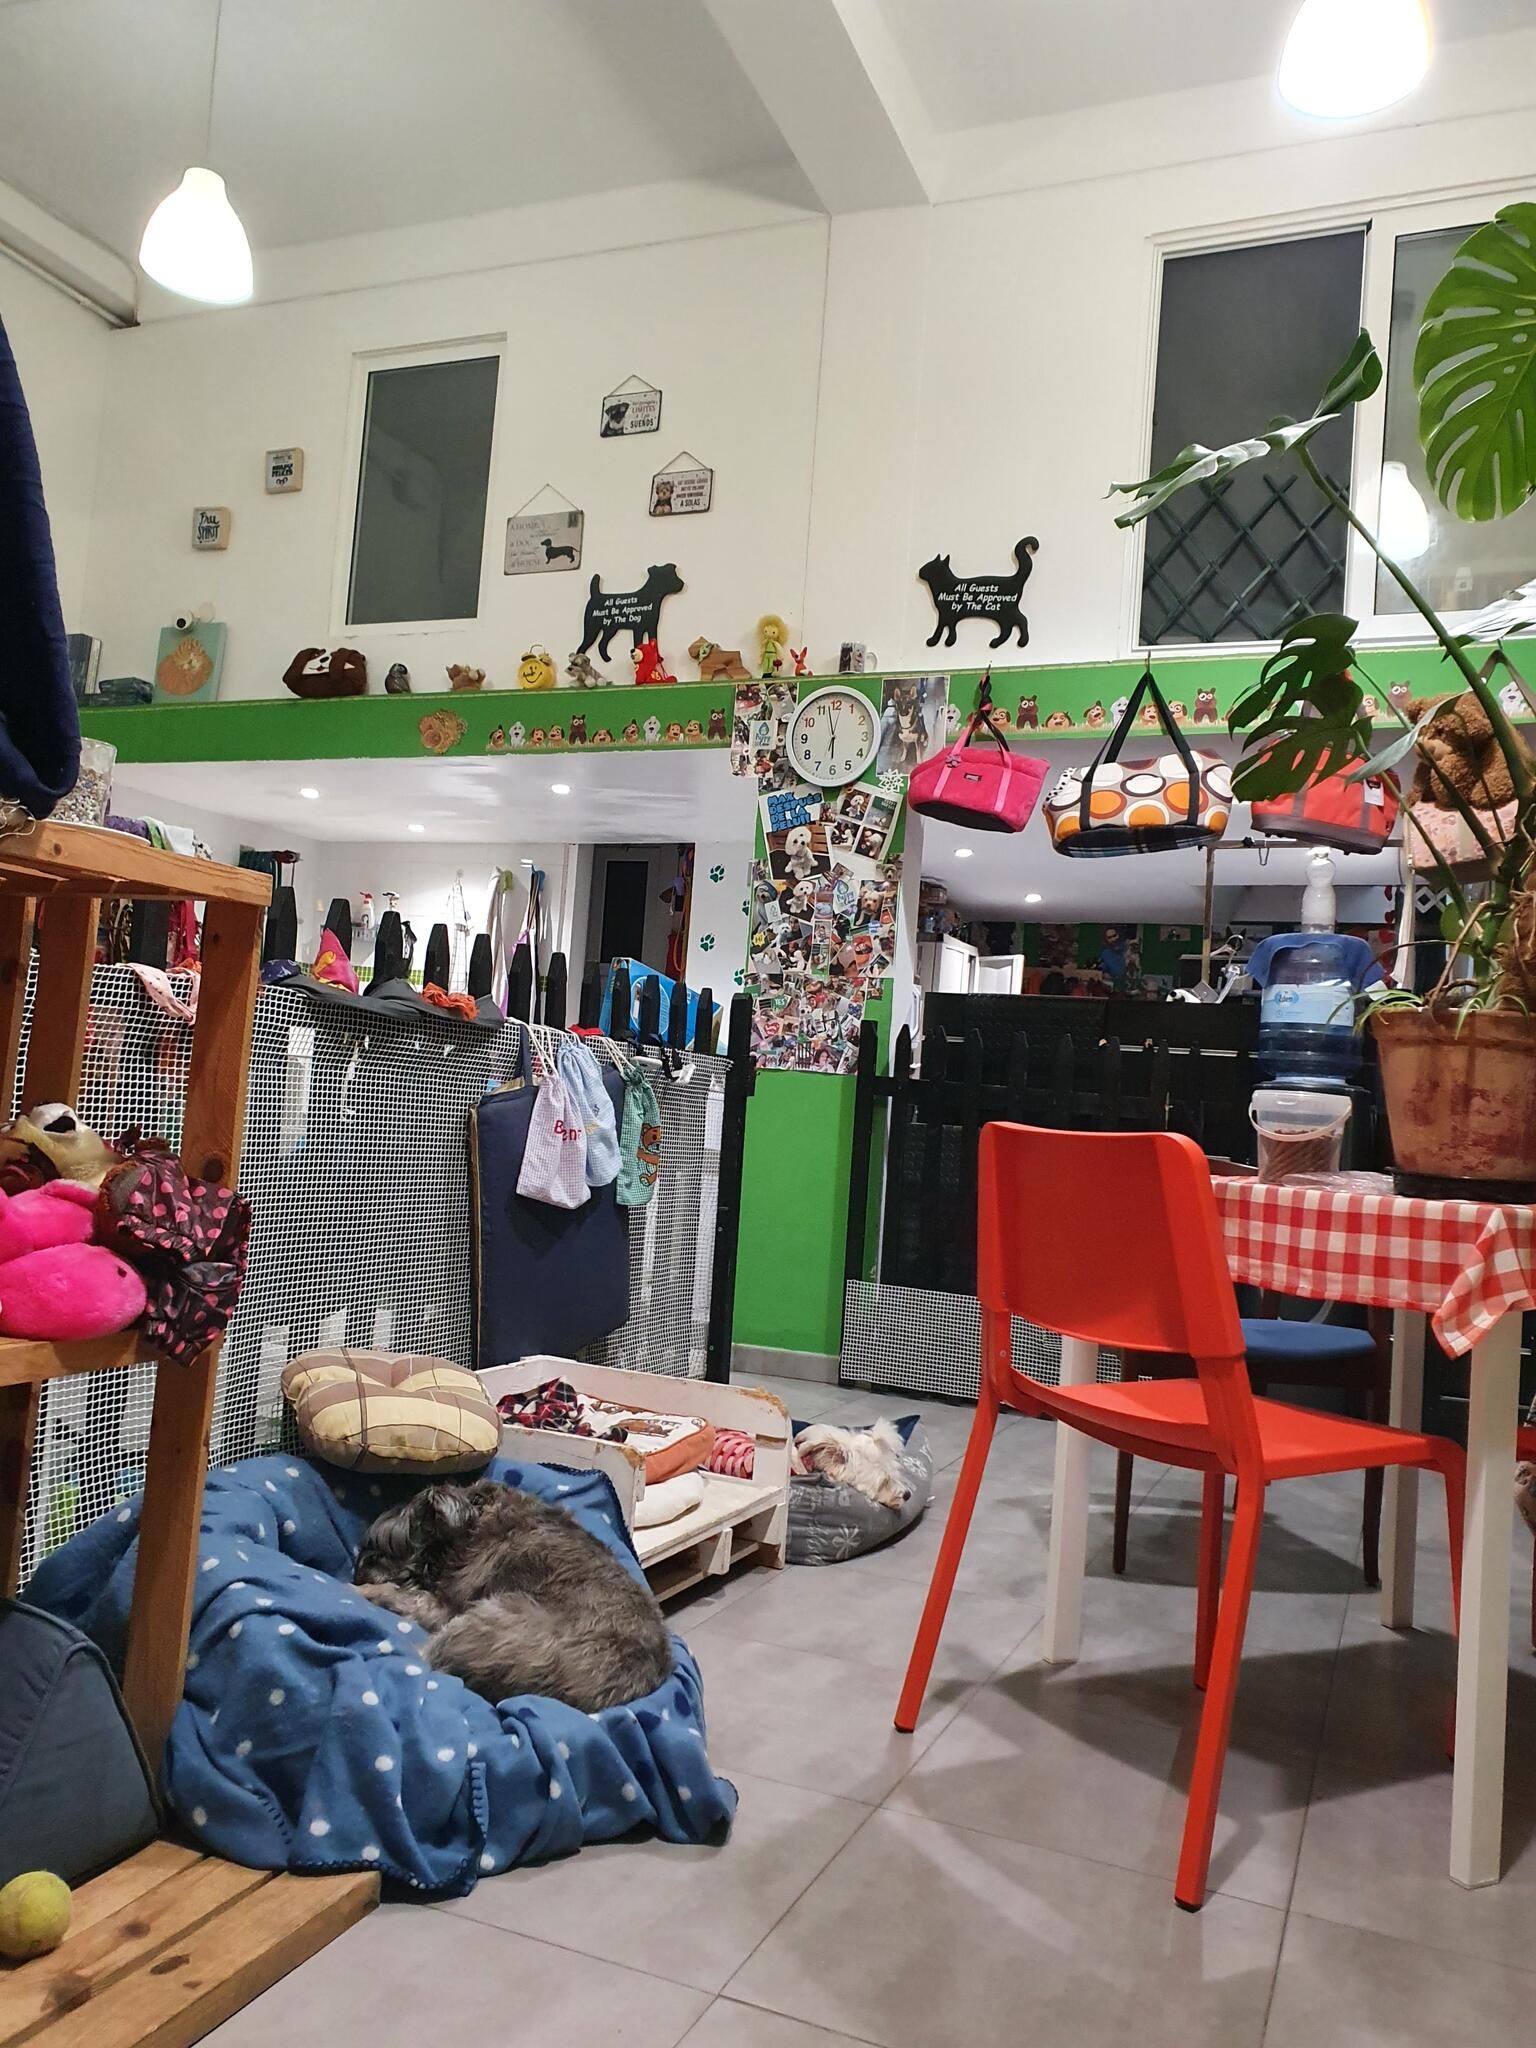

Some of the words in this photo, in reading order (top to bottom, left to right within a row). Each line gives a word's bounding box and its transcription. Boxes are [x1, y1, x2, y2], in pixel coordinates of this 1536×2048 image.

[954, 583, 966, 593] All
[969, 583, 999, 593] Guests
[604, 598, 614, 606] All
[615, 596, 638, 605] Guests
[938, 592, 960, 602] Must
[962, 593, 973, 602] Be
[976, 593, 1018, 604] Approved
[592, 608, 609, 617] Must
[611, 607, 619, 616] Be
[622, 602, 653, 615] Approved
[951, 603, 963, 612] by
[966, 602, 981, 611] The
[985, 602, 1001, 611] Cat
[603, 617, 612, 626] by
[614, 616, 626, 624] The
[628, 614, 642, 623] Dog
[817, 705, 826, 716] 11
[831, 700, 842, 711] 12
[849, 703, 854, 714] 1
[804, 717, 815, 728] 10
[858, 715, 866, 726] 2
[800, 733, 808, 744] 9
[861, 731, 869, 742] 3
[804, 749, 811, 760] 8
[856, 747, 864, 759] 4
[814, 761, 822, 771] 7
[829, 765, 836, 776] 6
[844, 759, 852, 771] 5
[767, 791, 794, 806] MAX
[769, 792, 823, 815] DESPUÉS
[770, 811, 786, 824] DE
[789, 806, 807, 818] LA
